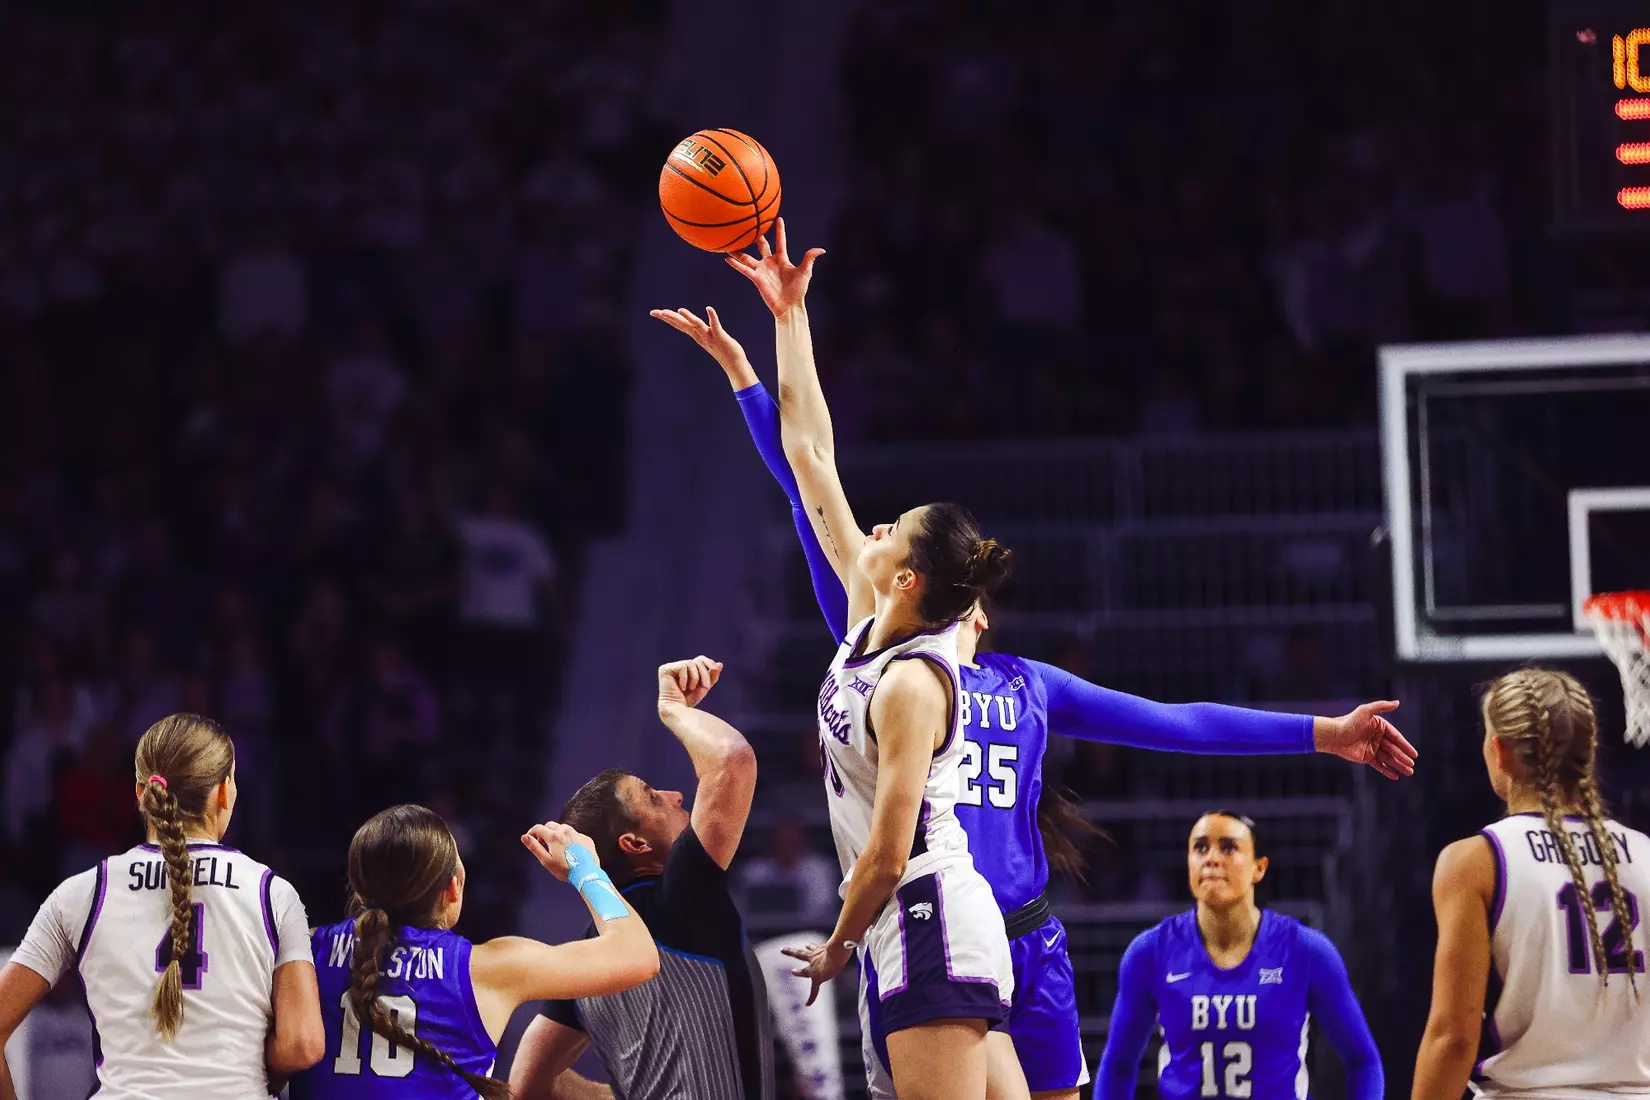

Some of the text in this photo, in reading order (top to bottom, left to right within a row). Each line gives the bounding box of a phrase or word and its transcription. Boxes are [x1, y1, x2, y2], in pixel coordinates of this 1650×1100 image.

[960, 690, 1017, 732] BYU
[957, 740, 1019, 809] 25
[128, 857, 240, 891] SUELL
[1526, 829, 1632, 866] GRGOY
[155, 902, 208, 990] 4
[1556, 880, 1645, 975] 12
[328, 933, 444, 981] WSTON
[333, 989, 417, 1078] 10
[1190, 993, 1257, 1031] BYU
[1200, 1040, 1253, 1099] 12
